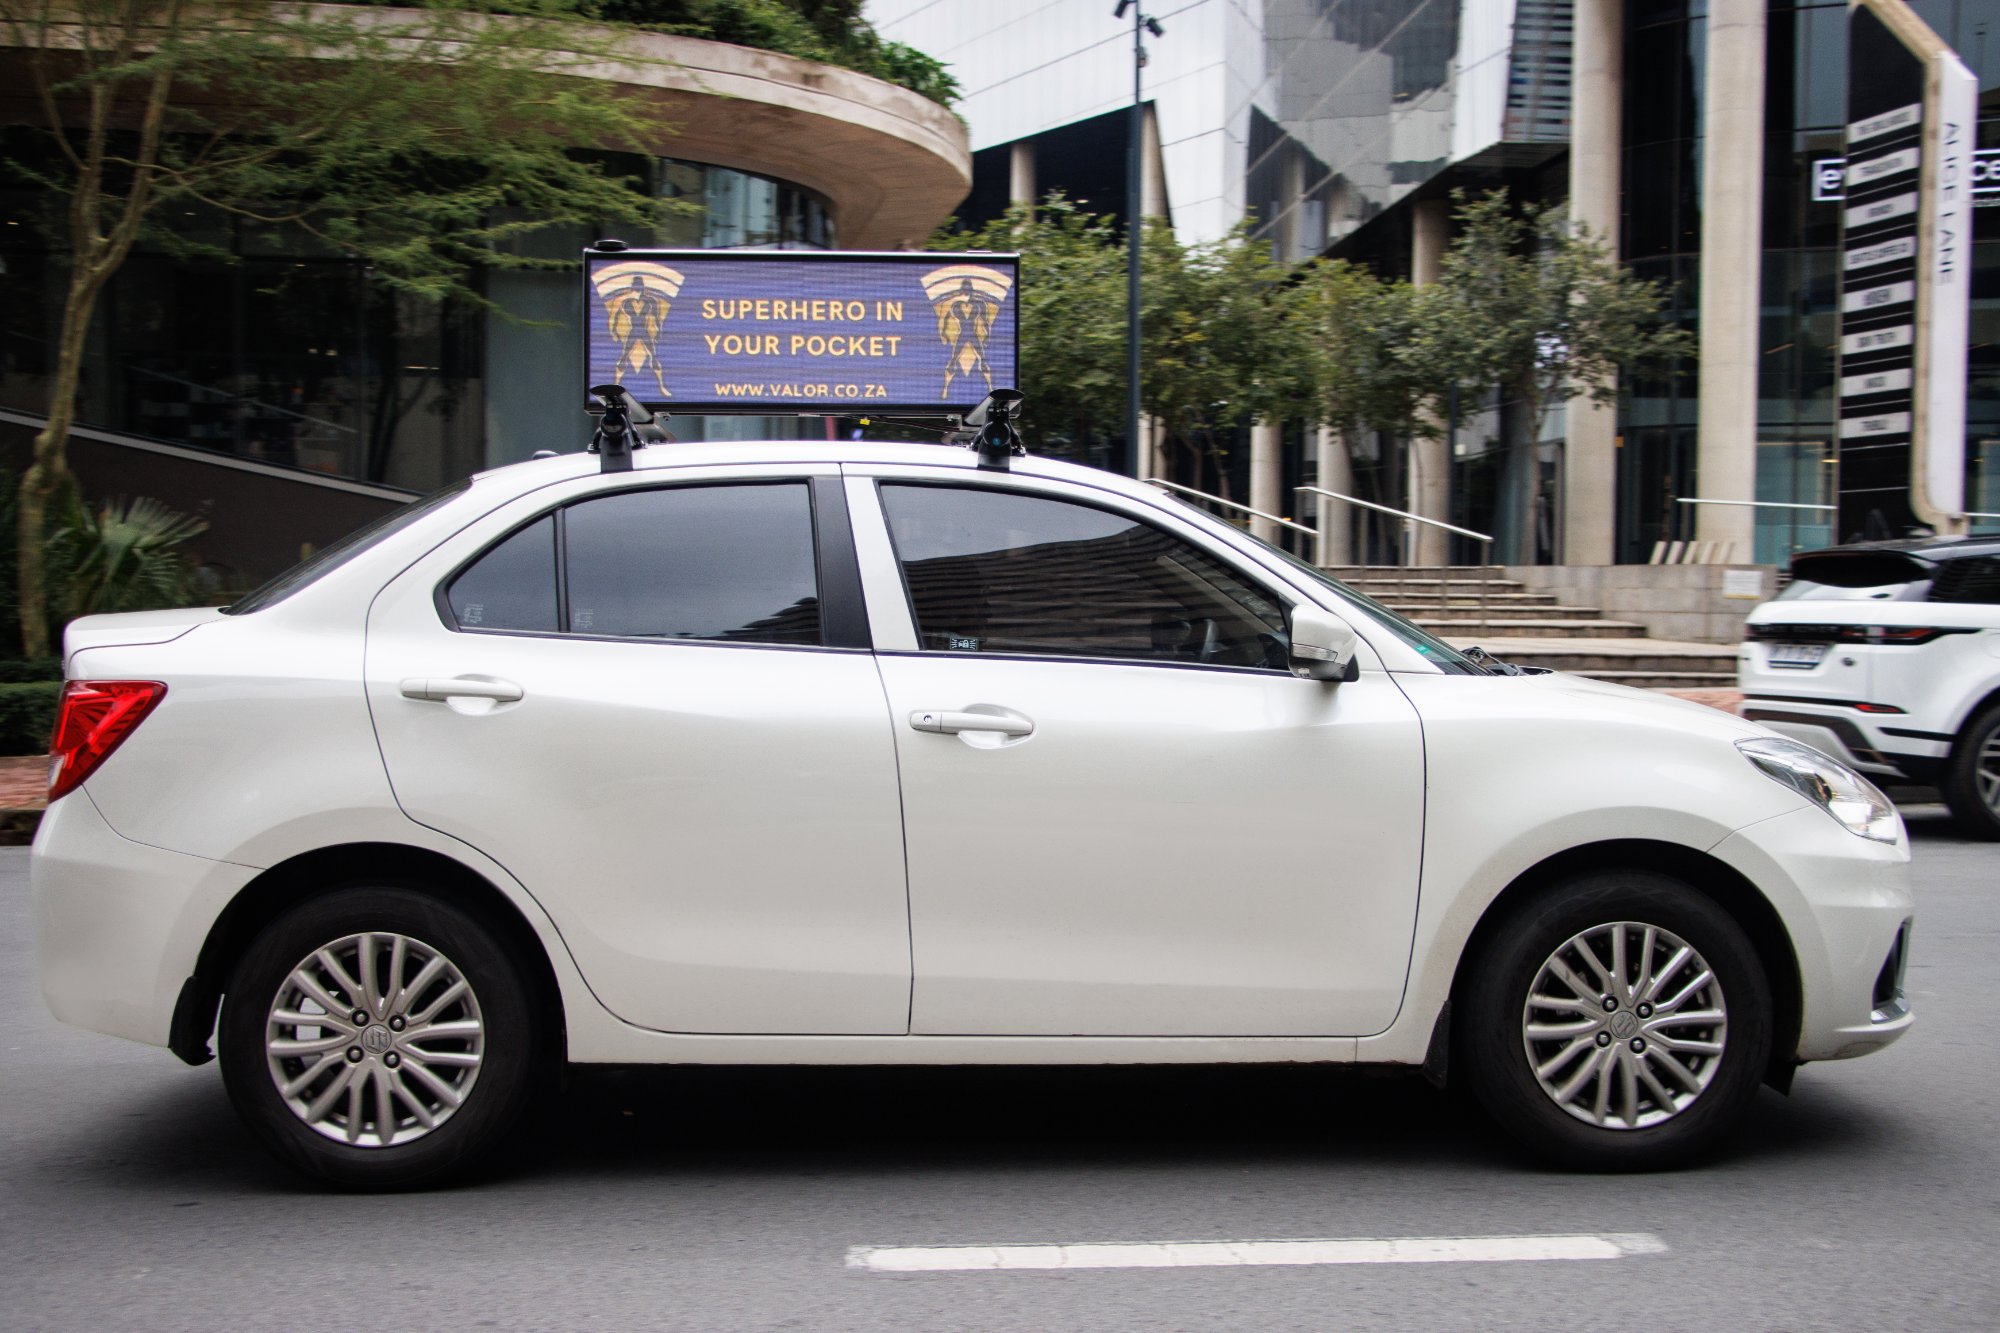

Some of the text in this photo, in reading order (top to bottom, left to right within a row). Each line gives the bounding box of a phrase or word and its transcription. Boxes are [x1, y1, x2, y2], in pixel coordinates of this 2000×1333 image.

[702, 299, 903, 322] SUPERHERO IN
[704, 334, 902, 357] YOUR POCKET
[715, 383, 887, 399] WWW.VALOR.CO.ZA
